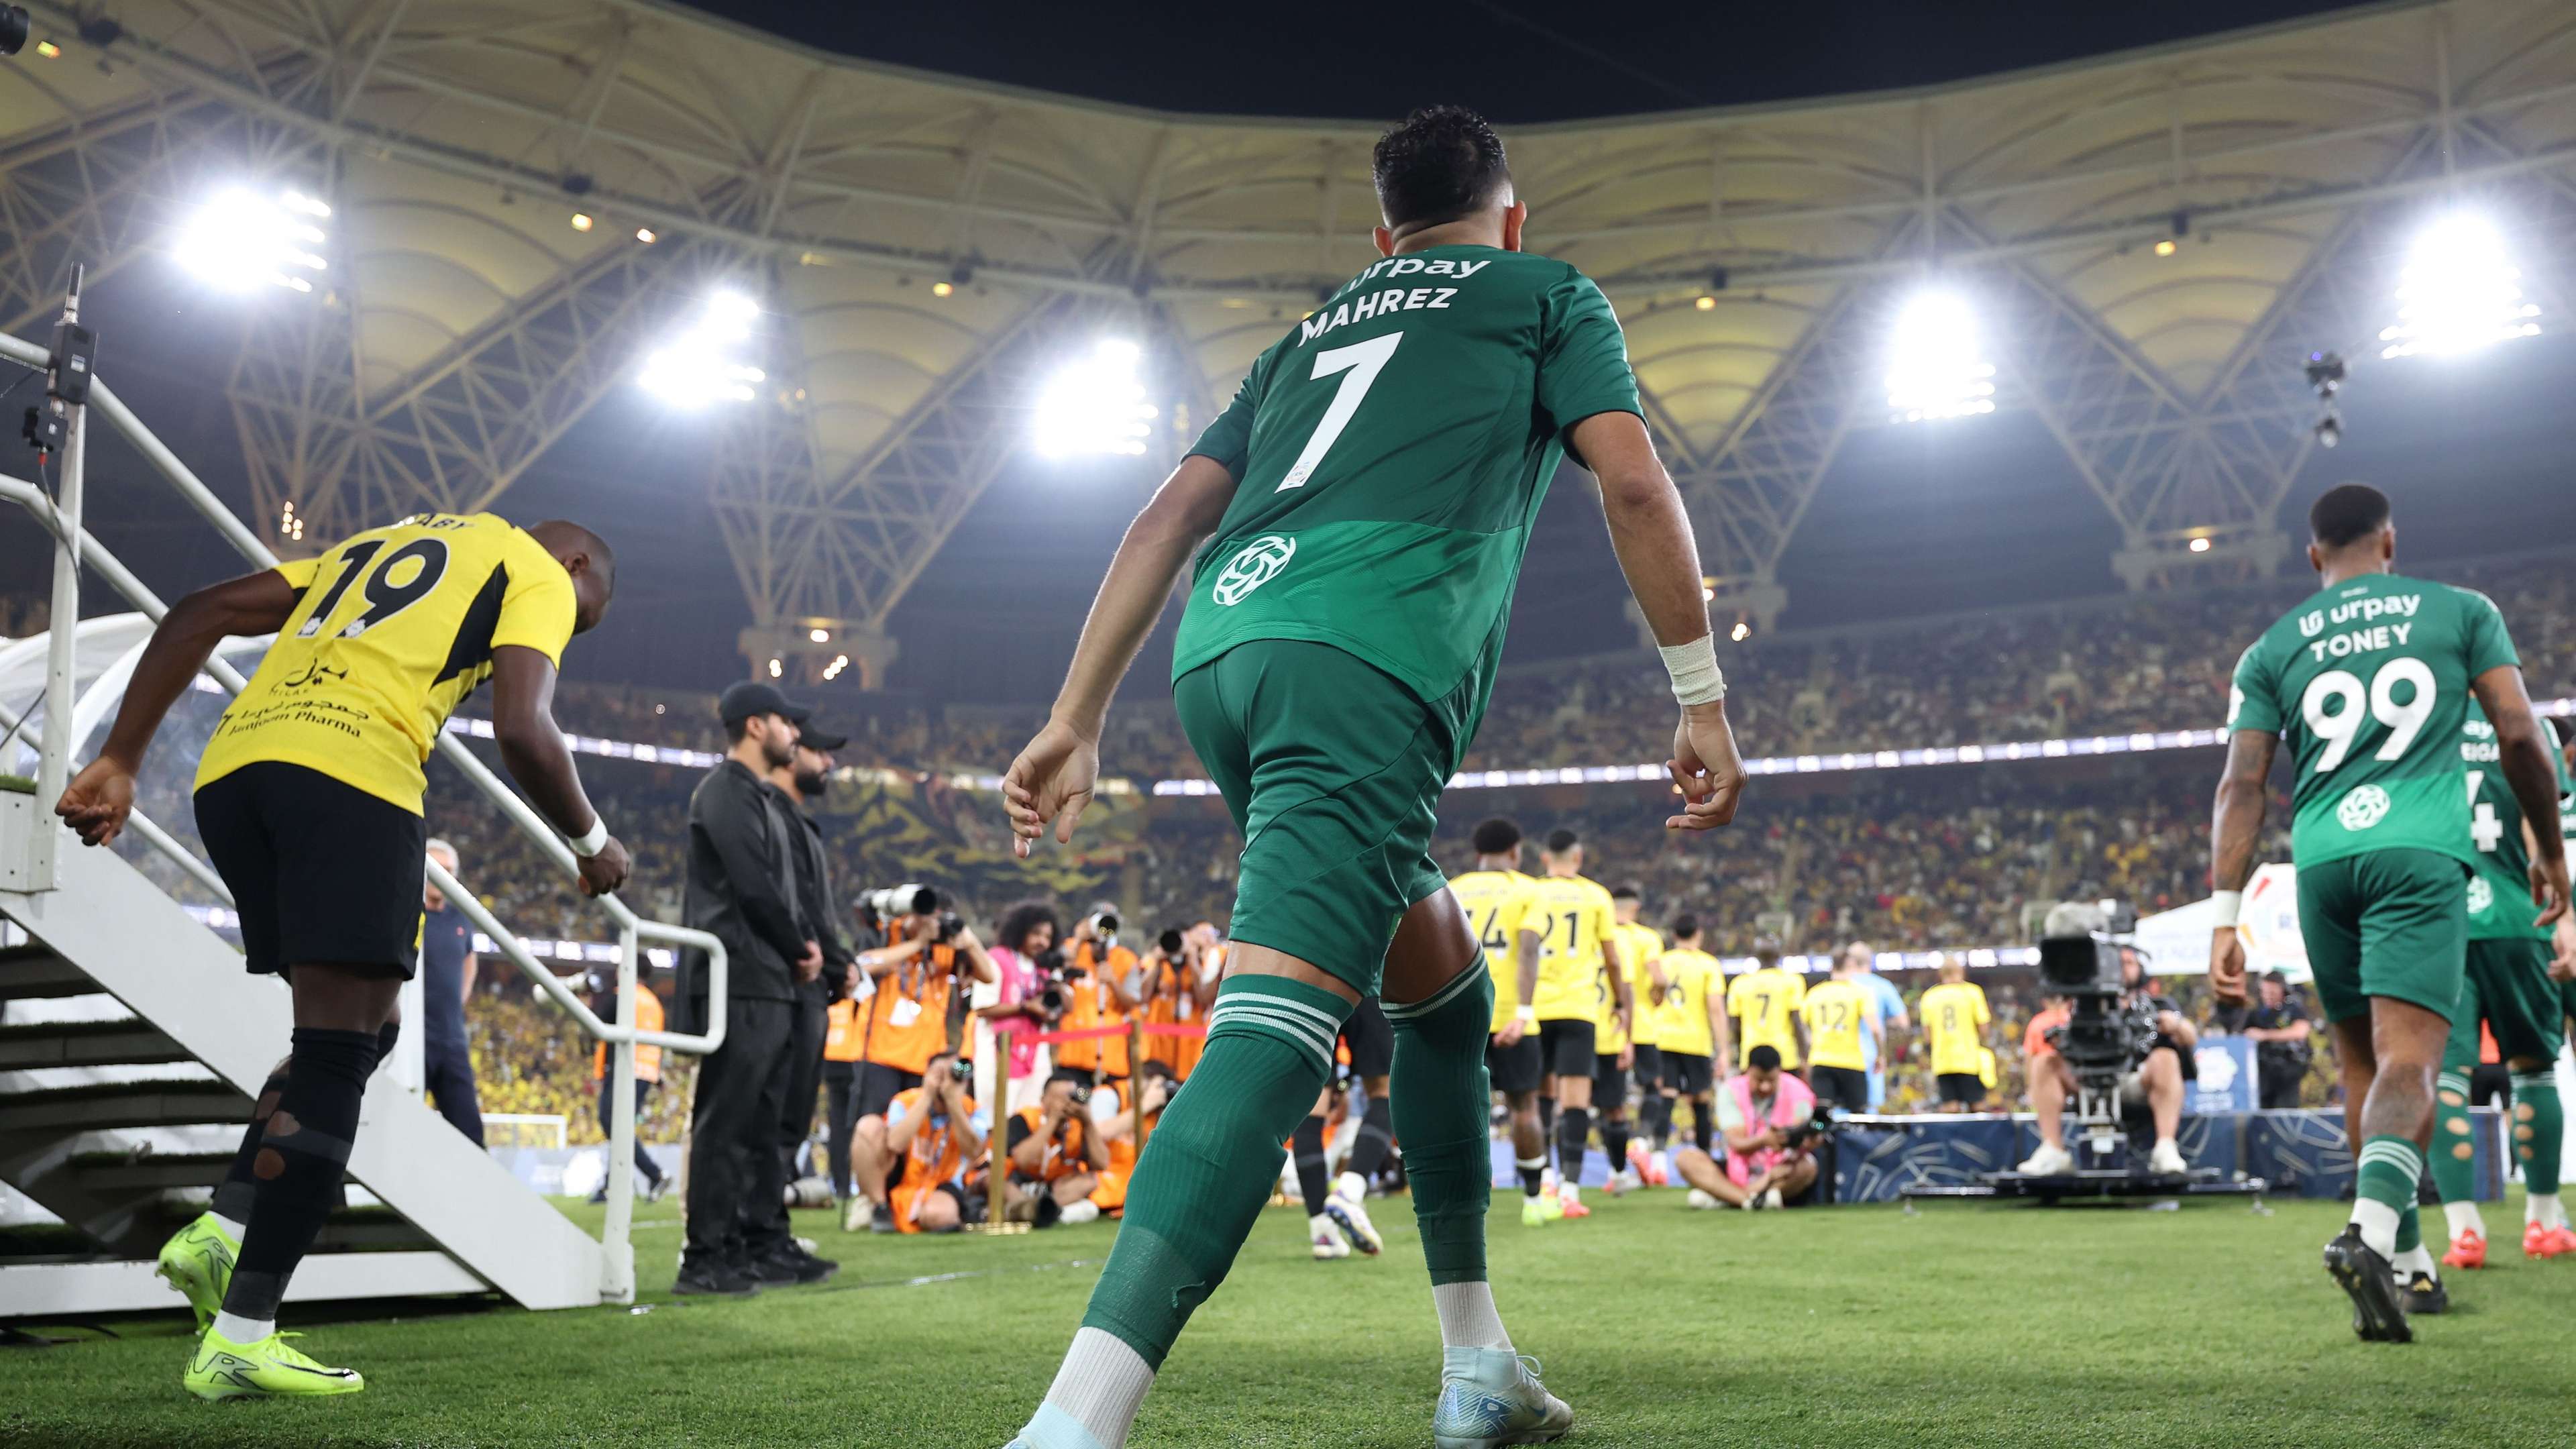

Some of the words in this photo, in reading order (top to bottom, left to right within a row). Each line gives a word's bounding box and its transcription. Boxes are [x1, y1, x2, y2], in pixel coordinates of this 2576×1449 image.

[1298, 288, 1458, 348] MAHREZ
[1274, 331, 1404, 494] 7
[296, 537, 450, 639] 19
[2330, 593, 2421, 625] urpay
[2309, 621, 2412, 662] TONEY
[294, 710, 361, 738] Pharma
[2302, 657, 2437, 773] 99
[1755, 993, 1771, 1026] 7
[1819, 1004, 1849, 1033] 12
[1941, 1004, 1958, 1032] 8
